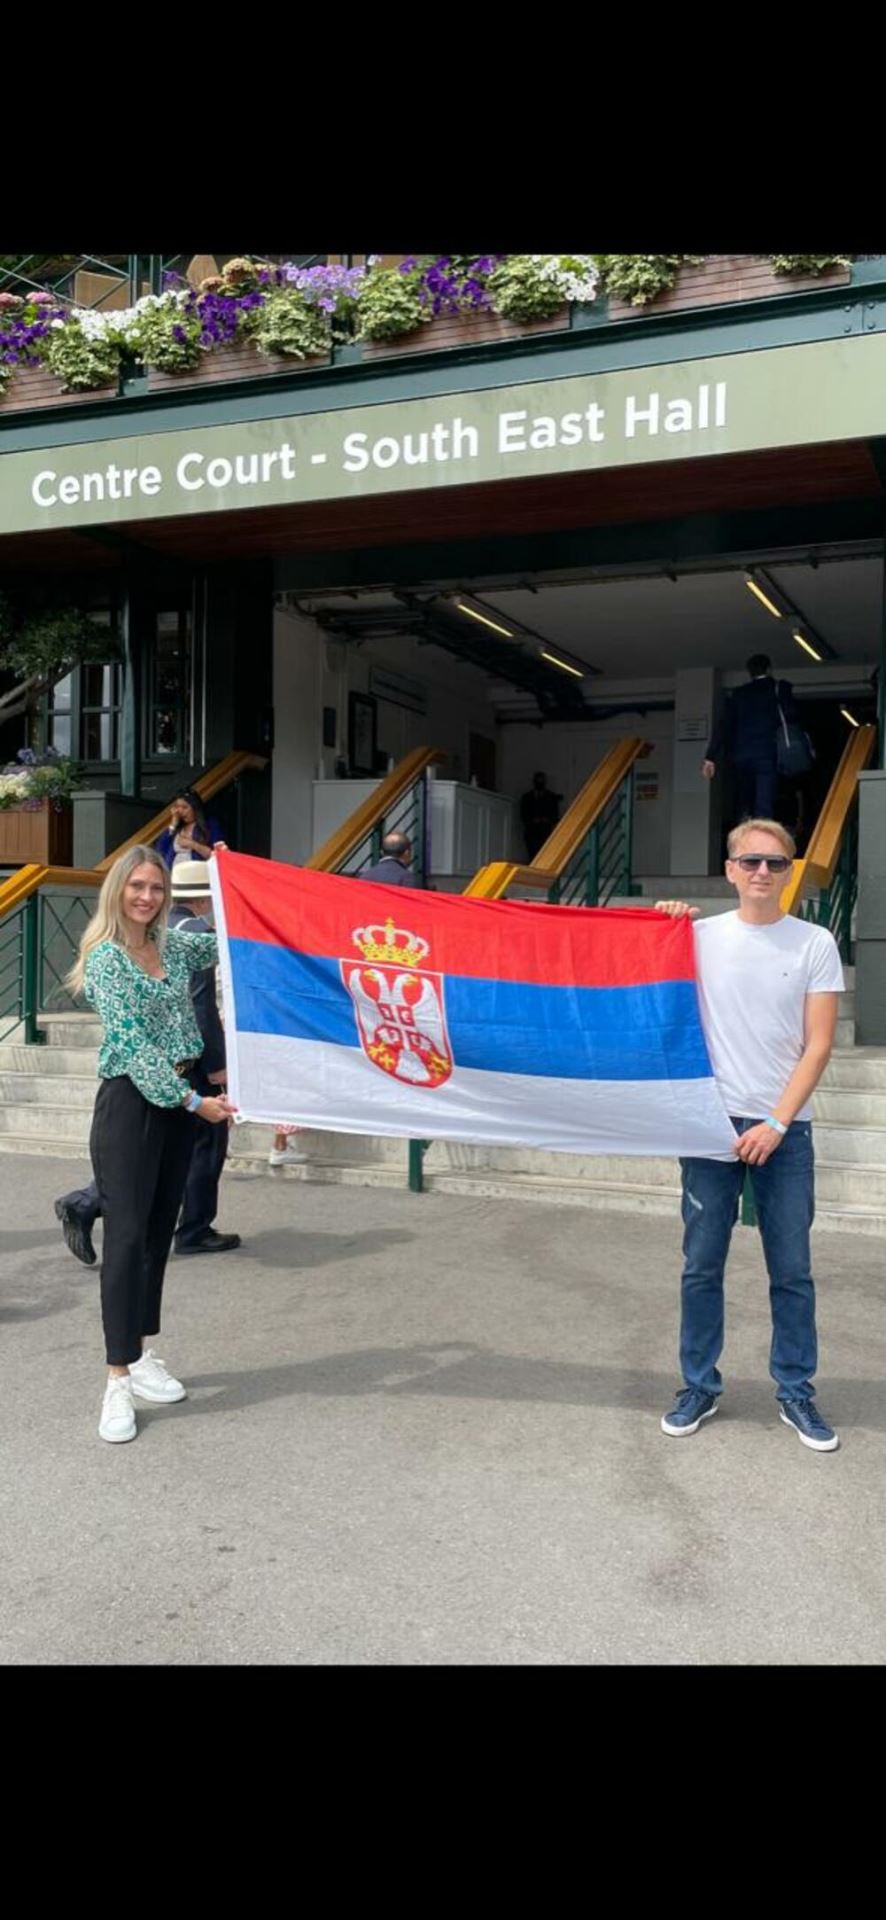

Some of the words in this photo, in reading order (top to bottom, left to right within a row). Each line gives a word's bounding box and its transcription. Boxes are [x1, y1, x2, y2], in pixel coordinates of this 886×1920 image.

[31, 464, 162, 507] Centre
[176, 443, 296, 491] Court
[342, 417, 479, 472] South
[497, 402, 605, 454] East
[624, 381, 727, 438] Hall
